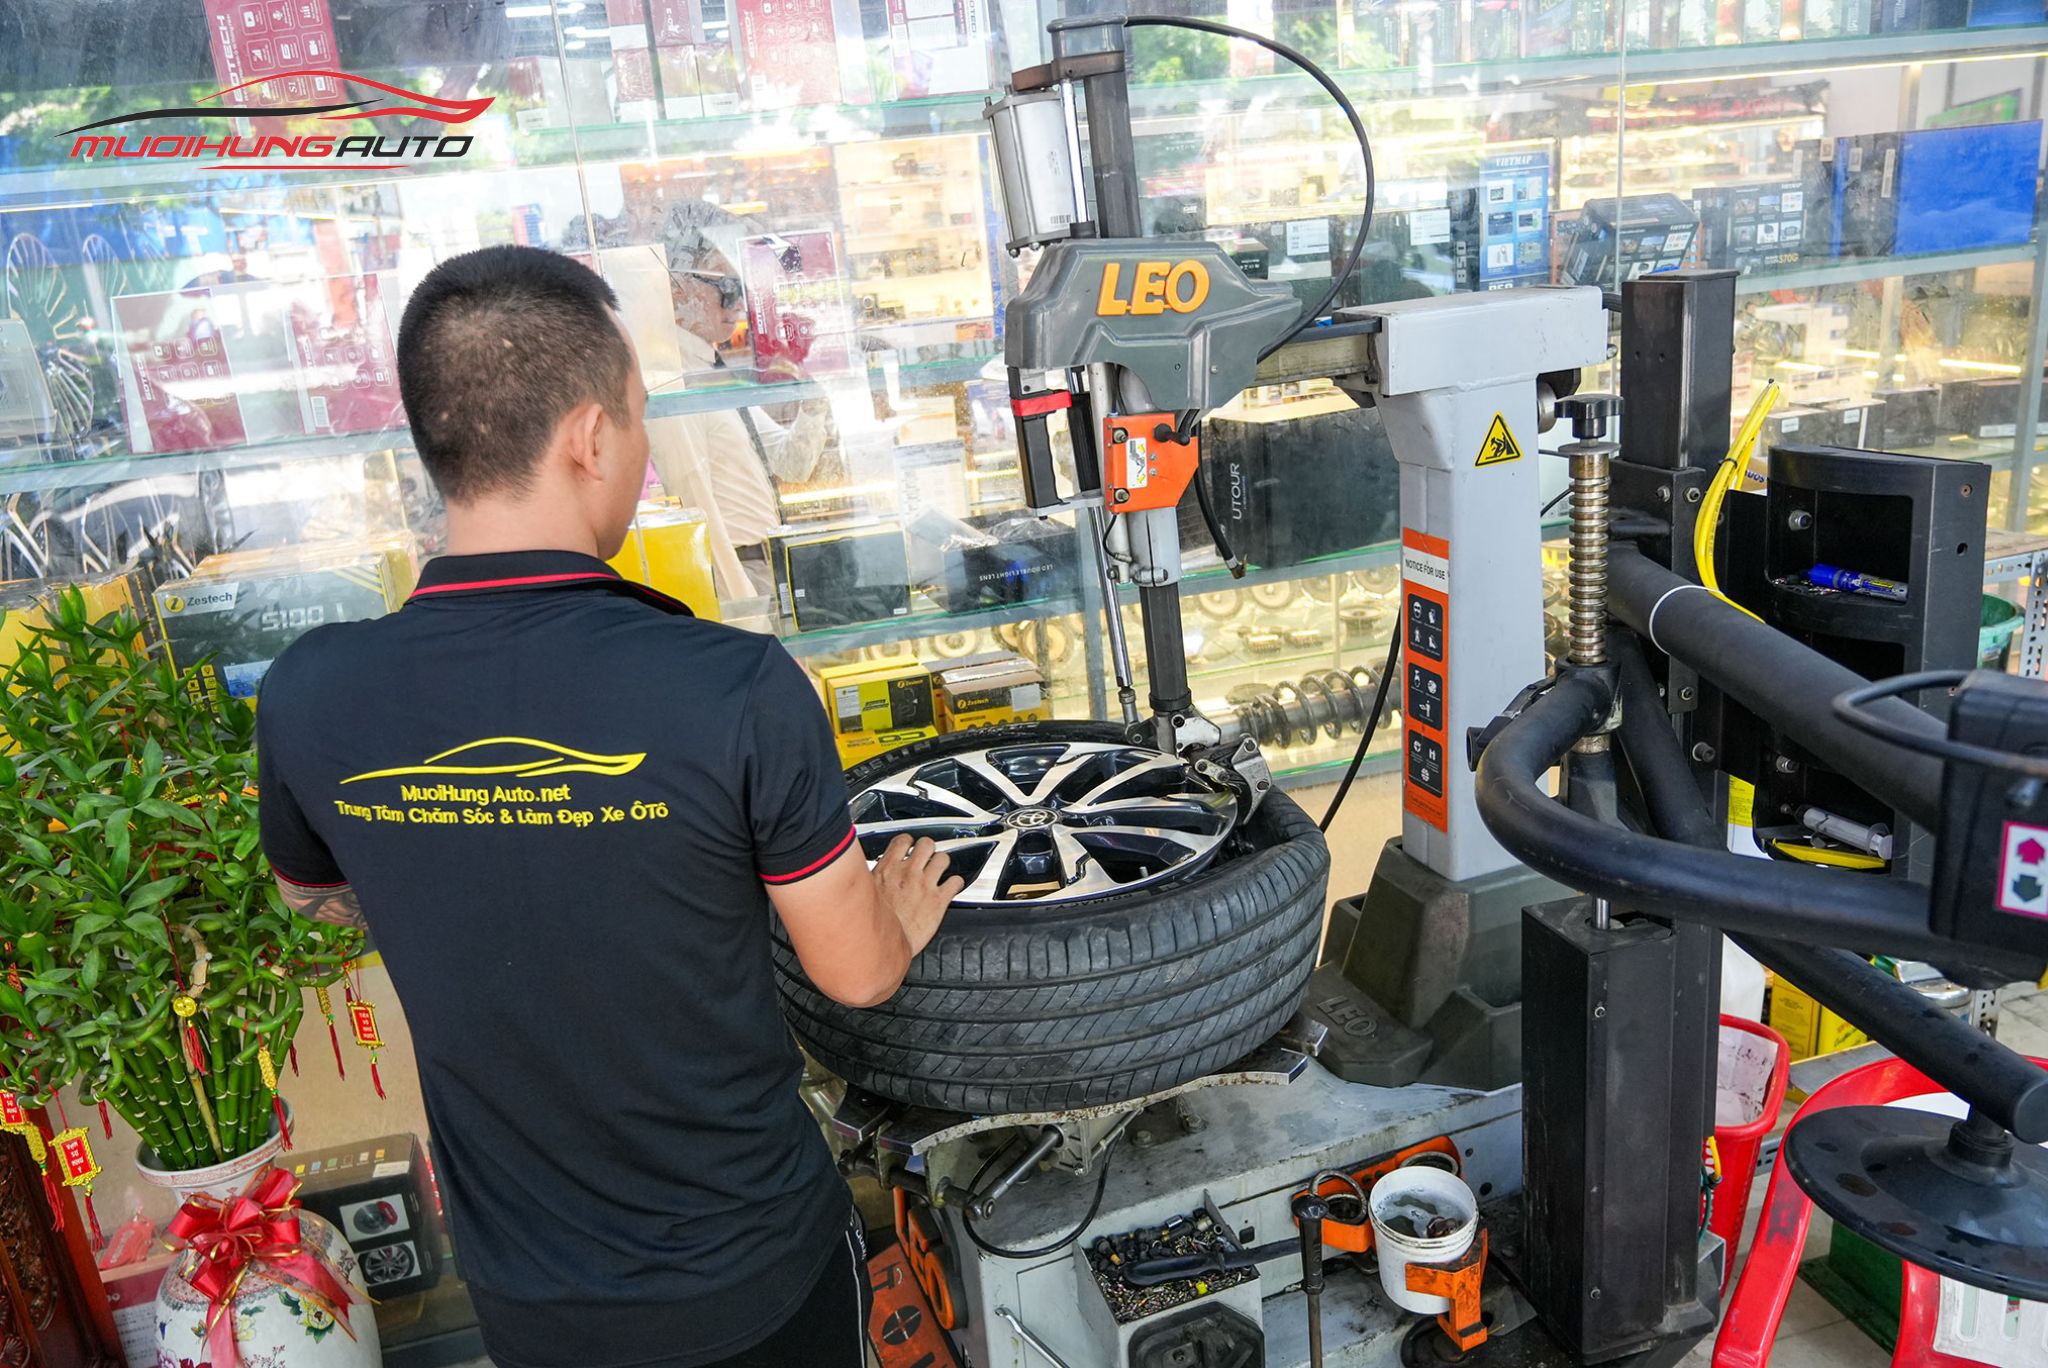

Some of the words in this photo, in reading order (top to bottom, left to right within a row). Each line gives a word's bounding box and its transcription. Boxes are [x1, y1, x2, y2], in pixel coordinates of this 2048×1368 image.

[1097, 259, 1211, 316] LEO
[1230, 462, 1242, 520] UTOUR
[1405, 558, 1423, 573] NOTICE
[1424, 564, 1434, 576] FOR
[1435, 568, 1446, 580] USE
[187, 591, 233, 608] Zestech
[400, 784, 489, 806] MuoiHung
[492, 784, 572, 803] Auto.net
[334, 800, 372, 822] Trung
[408, 807, 460, 824] Chăm
[462, 808, 495, 824] Sóc
[500, 808, 514, 824] &
[516, 808, 554, 825] Làm
[557, 809, 594, 828] Đẹp
[600, 806, 625, 823] Xe
[1316, 994, 1378, 1038] LEO
